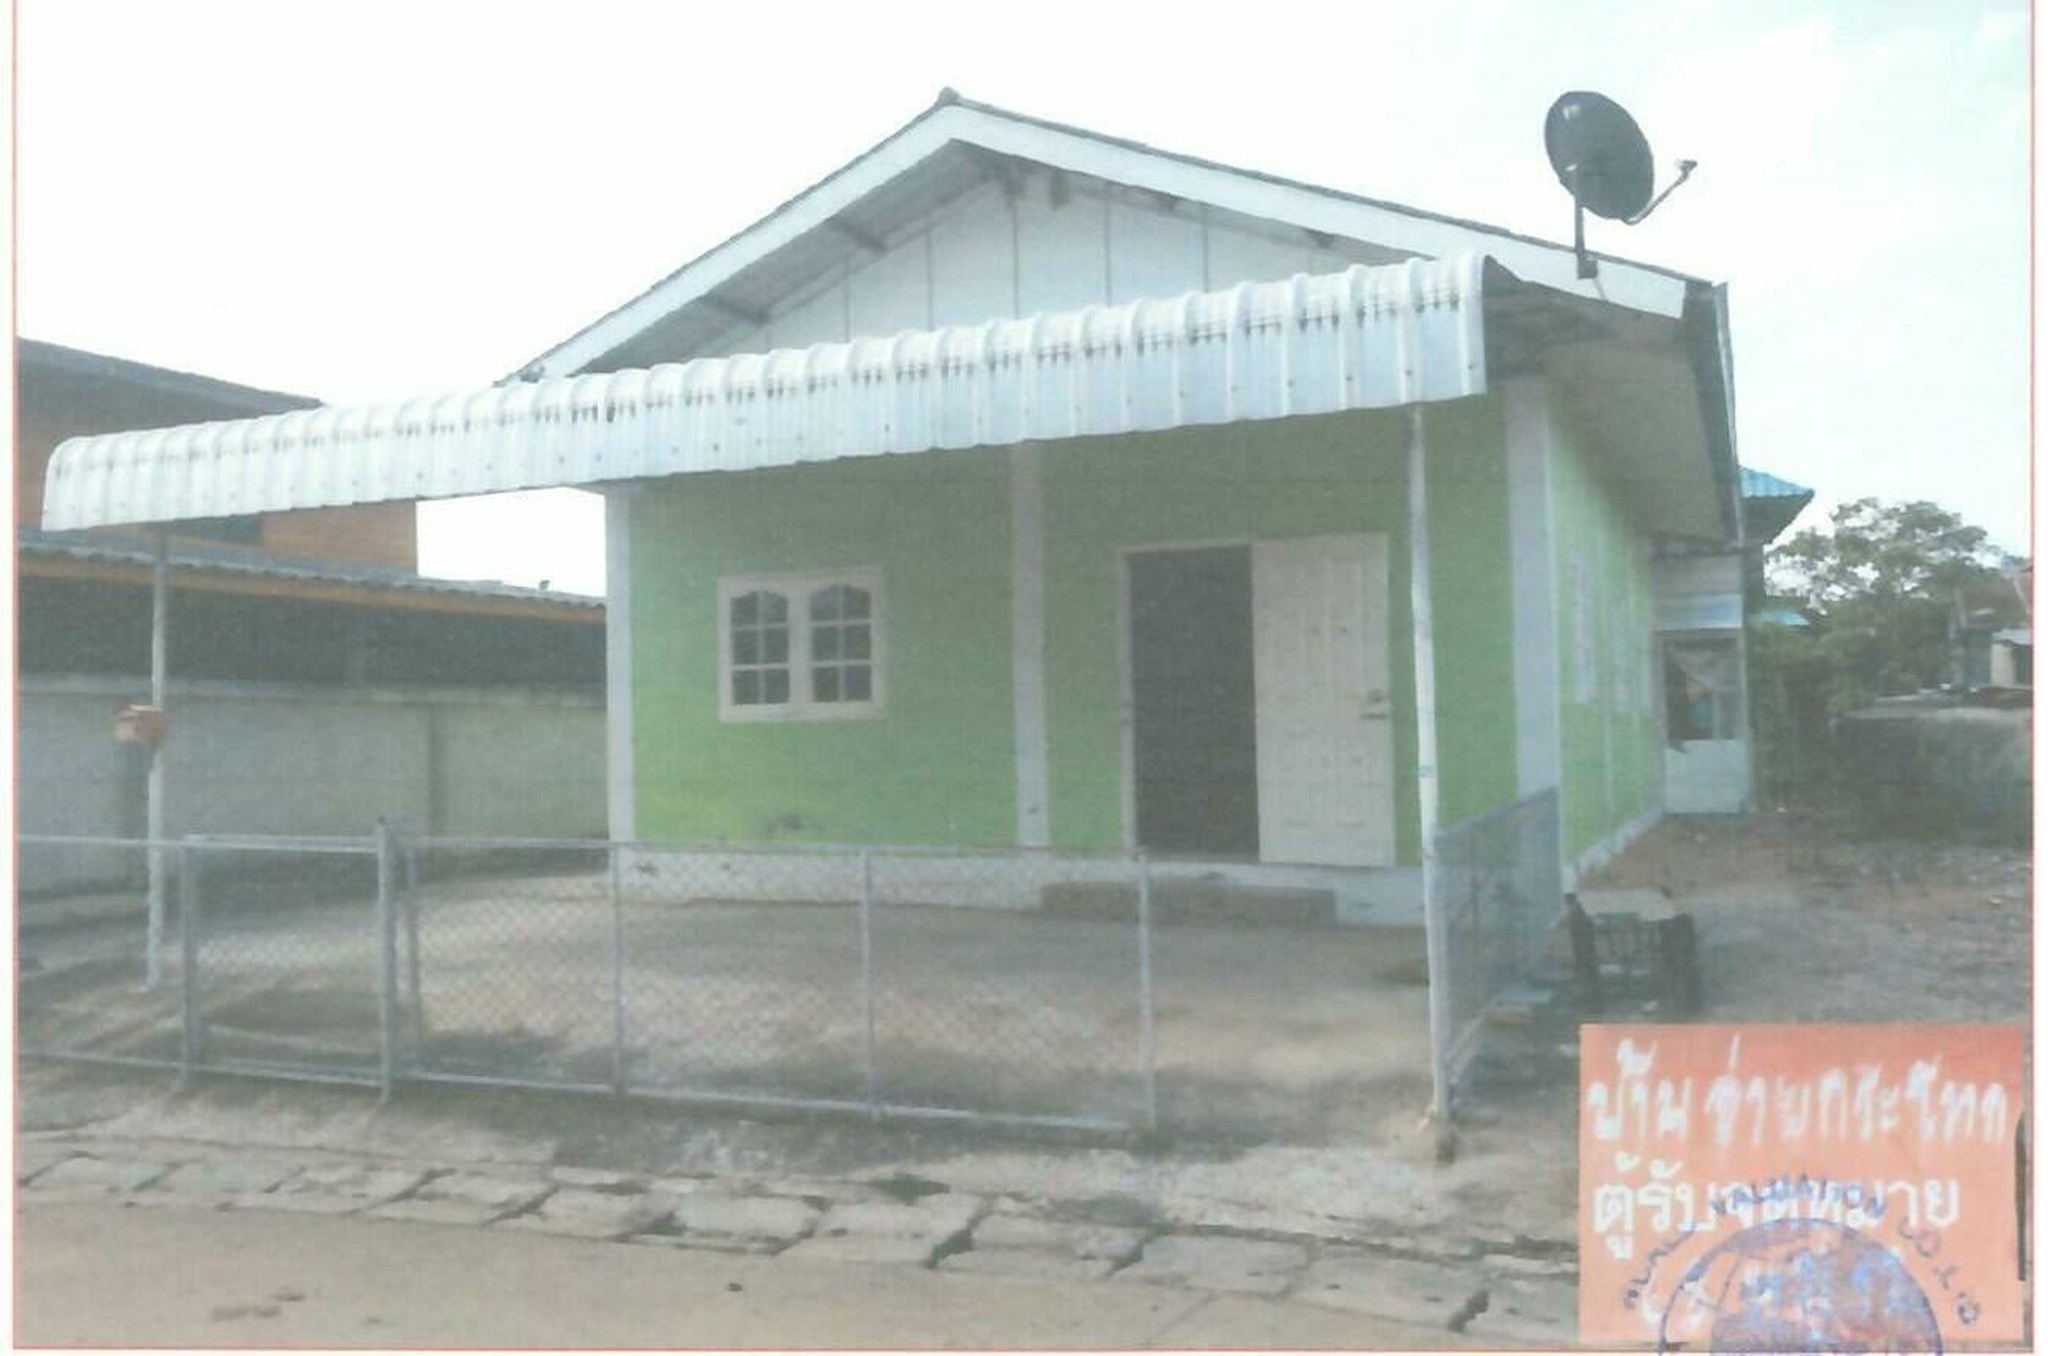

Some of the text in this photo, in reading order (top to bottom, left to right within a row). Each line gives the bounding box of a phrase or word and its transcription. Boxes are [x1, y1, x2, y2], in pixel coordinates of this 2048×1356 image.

[1593, 1150, 1961, 1260] ตู้รับจดหมาย
